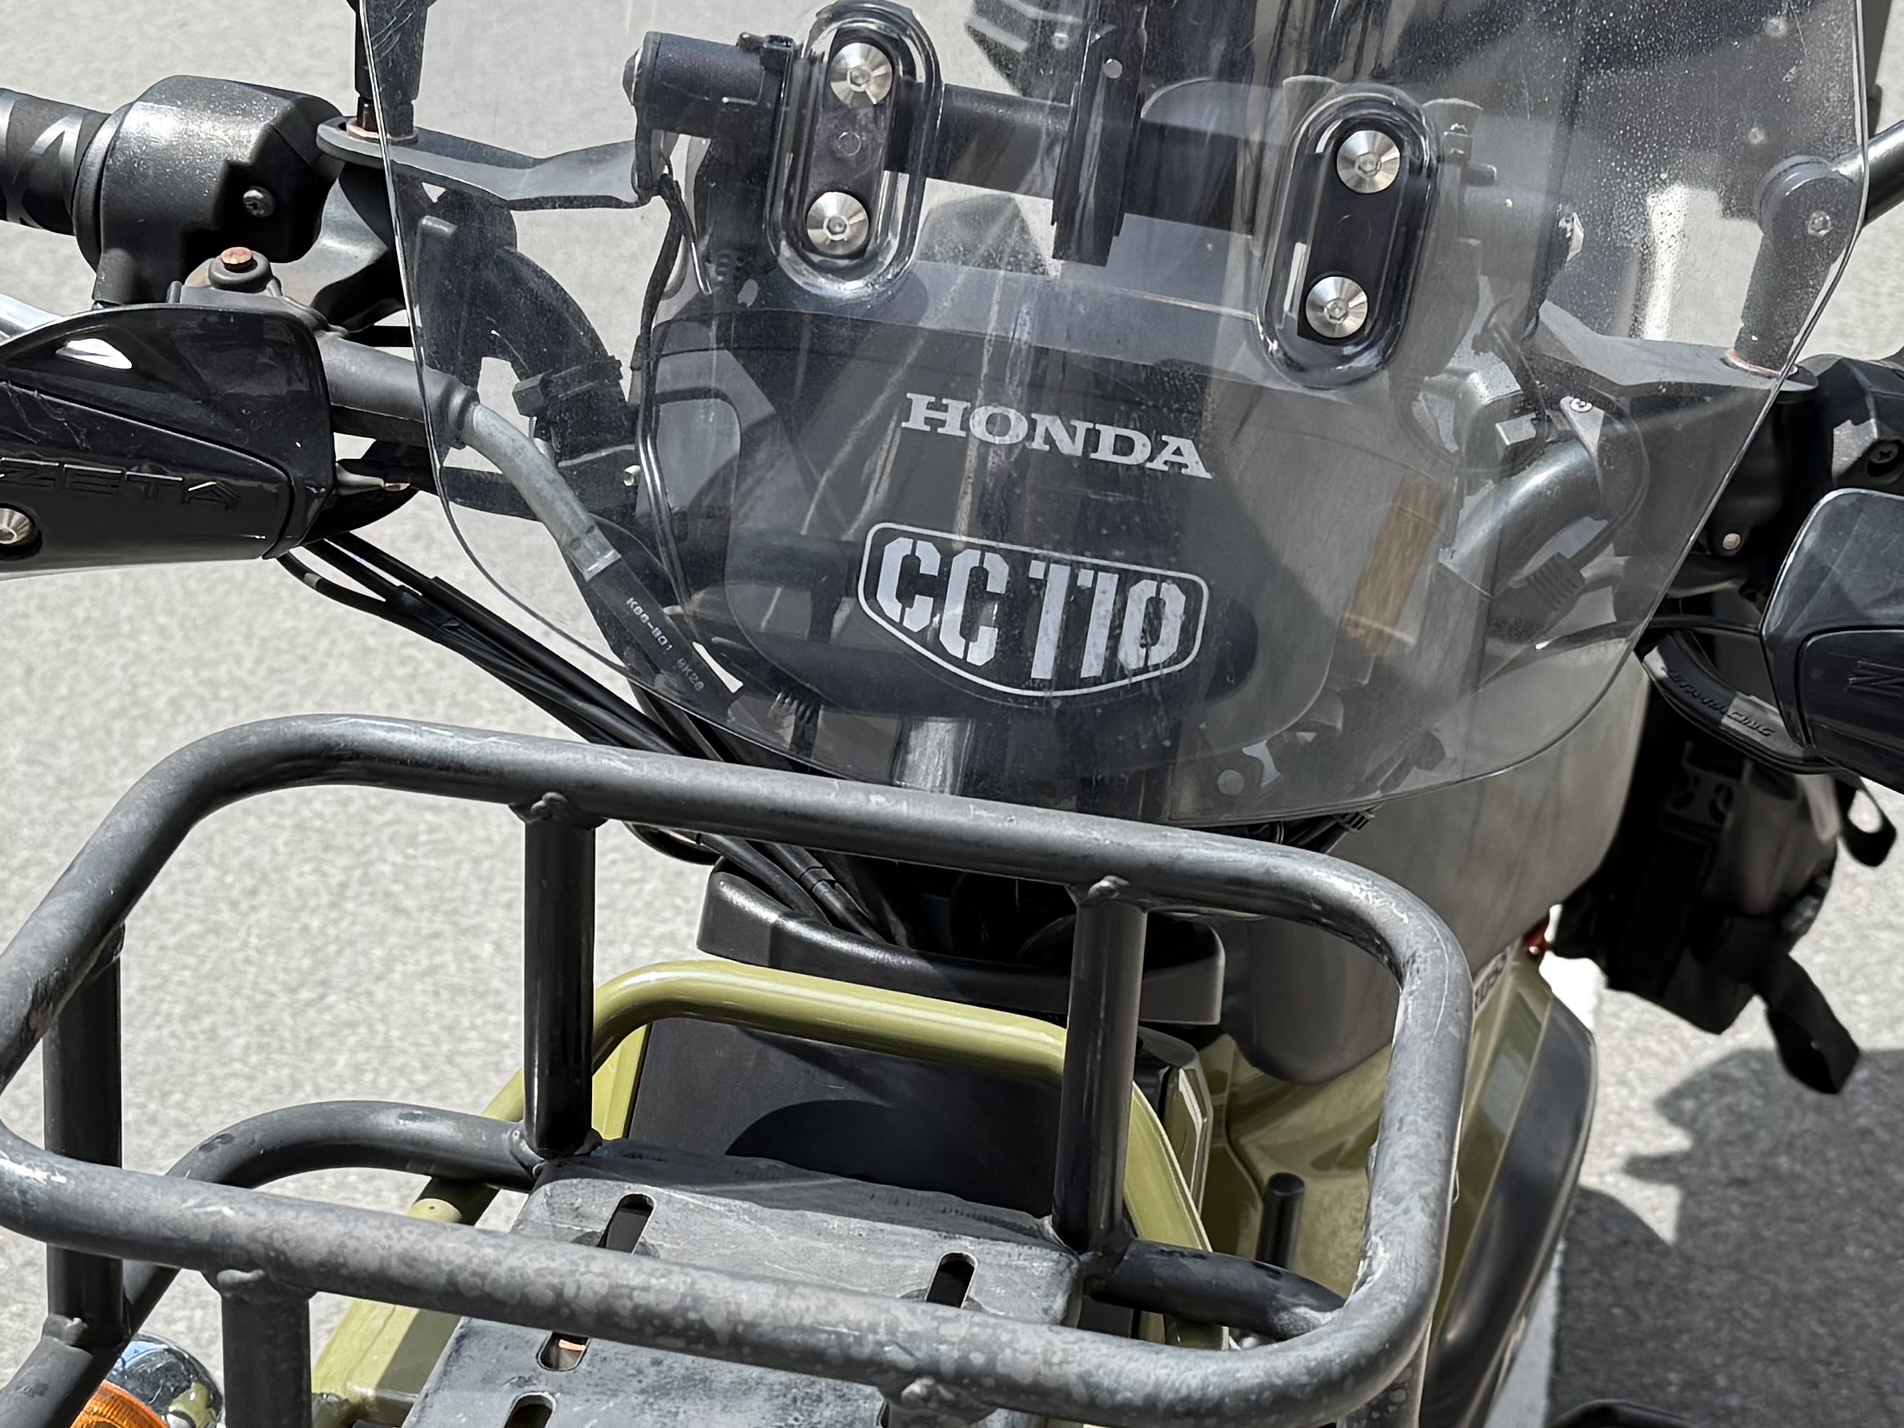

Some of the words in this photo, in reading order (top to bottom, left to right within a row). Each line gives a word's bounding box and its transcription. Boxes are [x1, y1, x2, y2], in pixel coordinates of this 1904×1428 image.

[900, 392, 1213, 480] HONDA
[875, 536, 1010, 667] CC
[1028, 559, 1187, 680] 110
